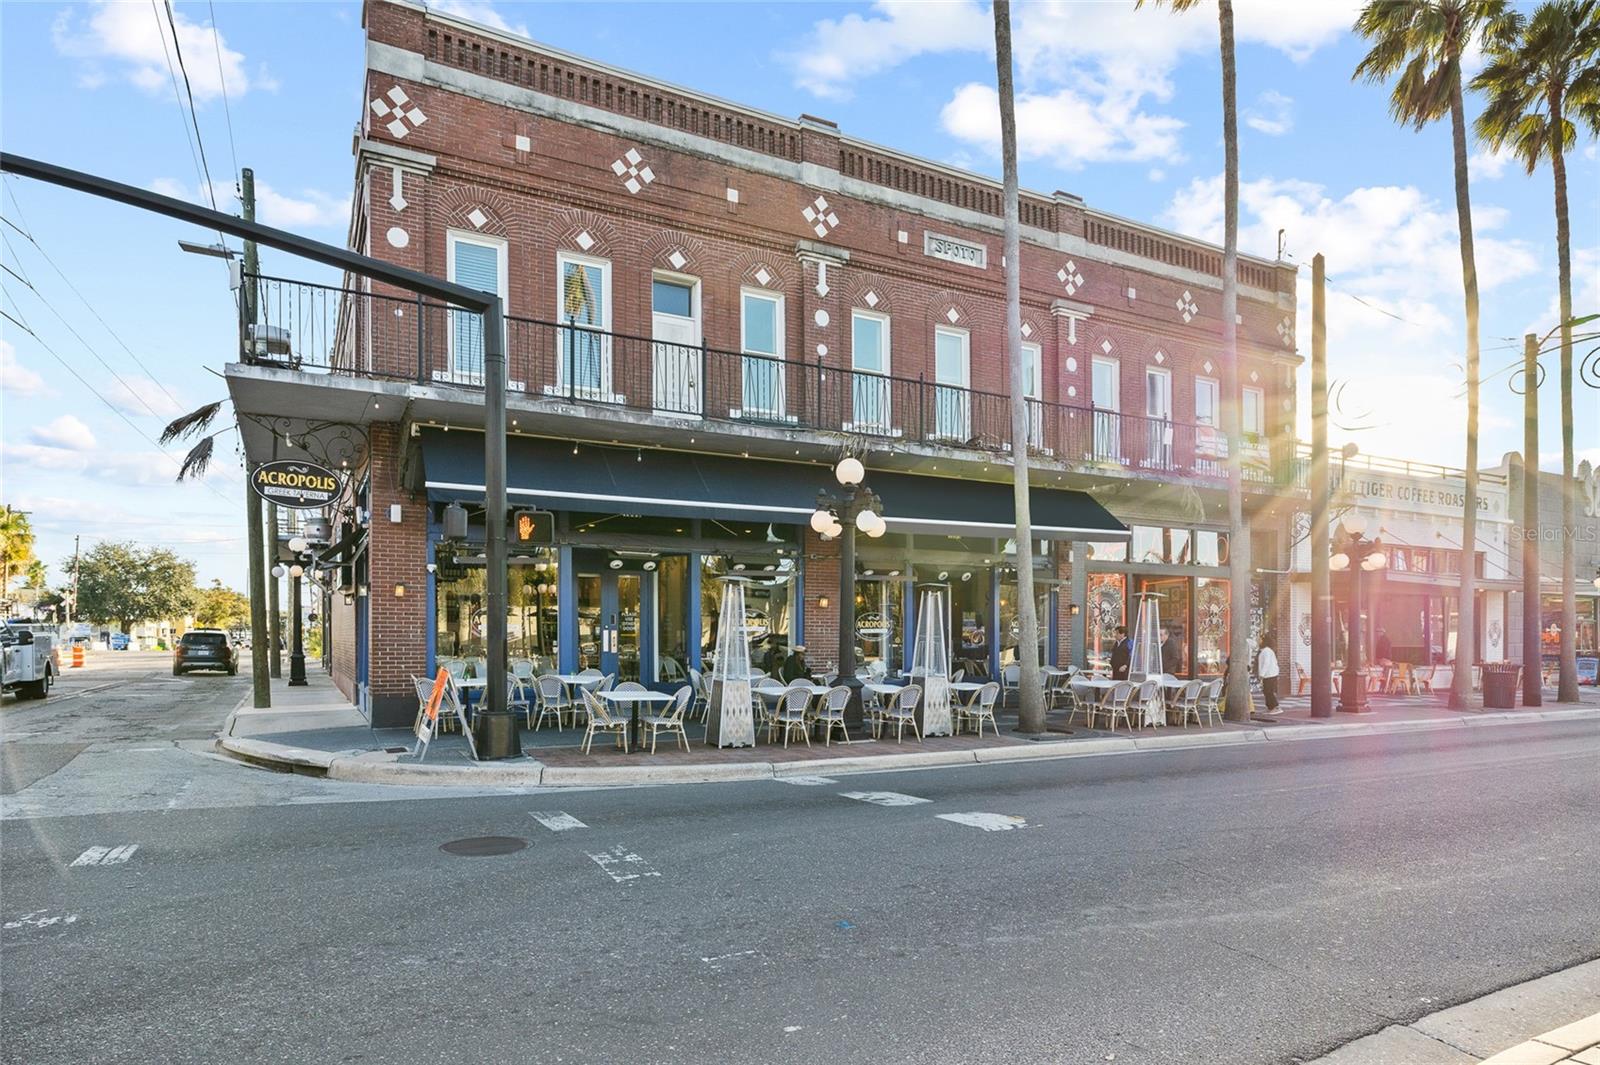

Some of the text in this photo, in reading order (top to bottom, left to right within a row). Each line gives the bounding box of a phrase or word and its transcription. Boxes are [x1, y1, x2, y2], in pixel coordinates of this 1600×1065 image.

[935, 241, 975, 260] SPOTO
[258, 471, 336, 490] ACROPOLIS
[268, 487, 291, 496] GREEK
[1360, 480, 1393, 498] TIGER
[1398, 486, 1435, 504] COFFEE
[1438, 493, 1488, 511] ROASRS
